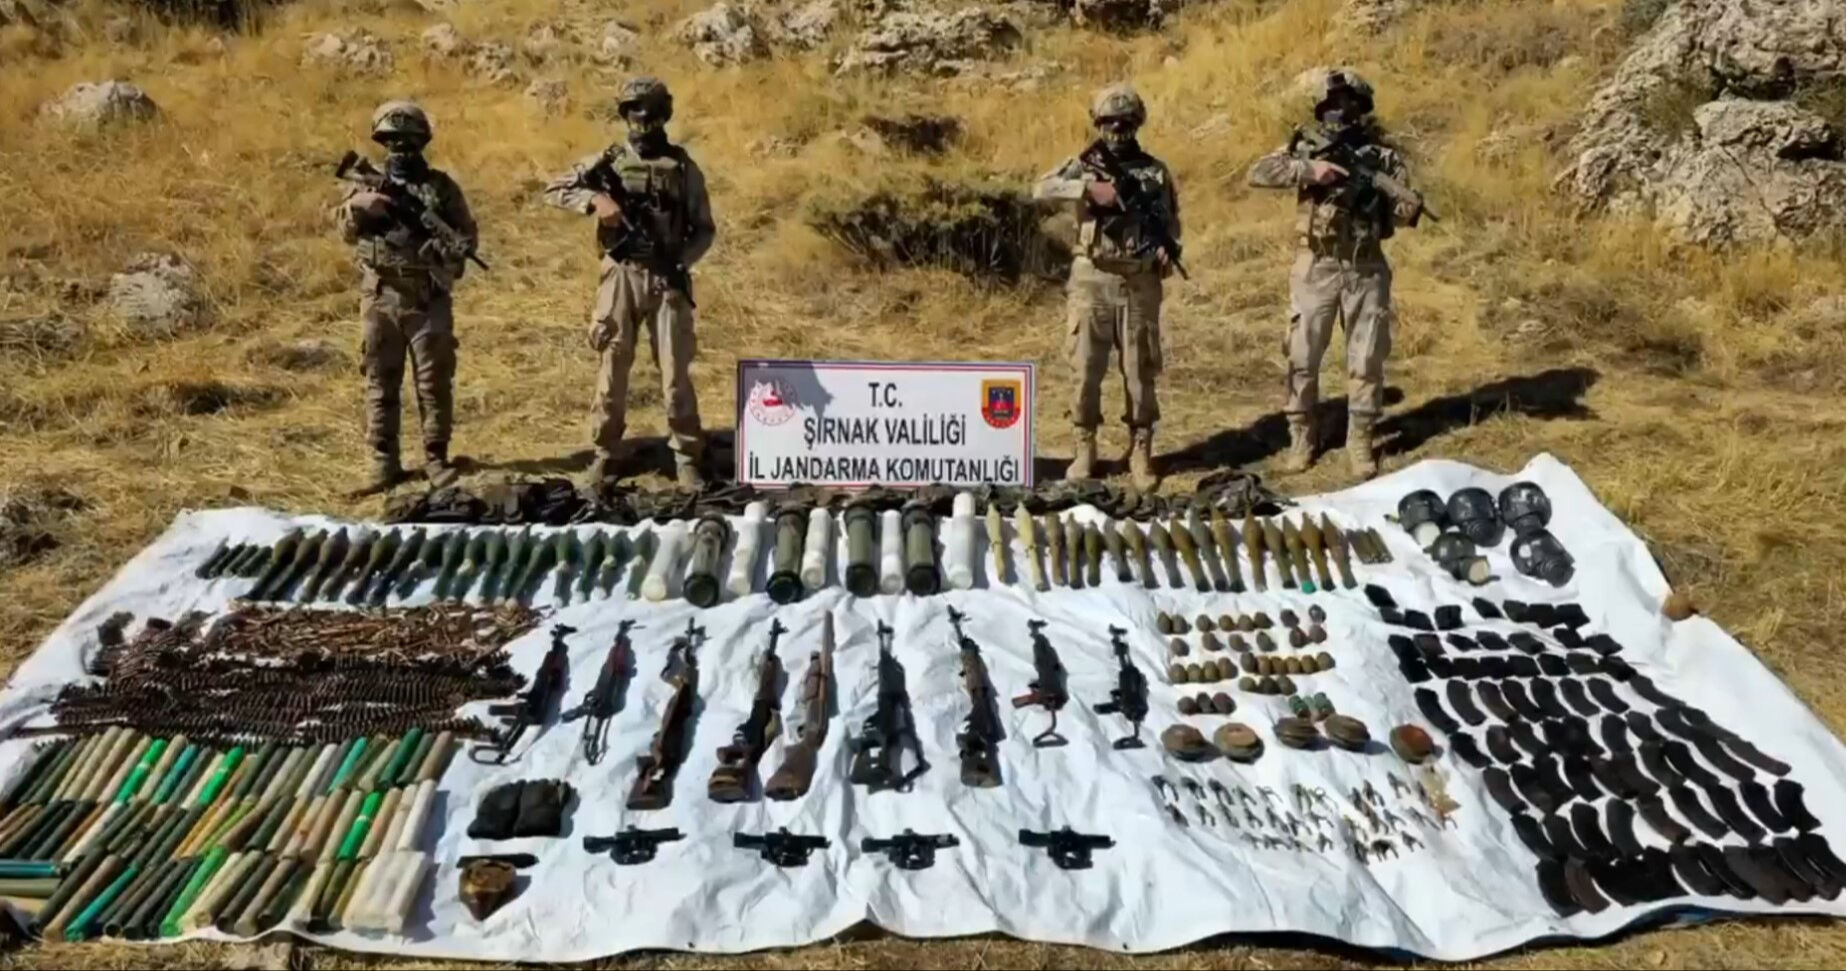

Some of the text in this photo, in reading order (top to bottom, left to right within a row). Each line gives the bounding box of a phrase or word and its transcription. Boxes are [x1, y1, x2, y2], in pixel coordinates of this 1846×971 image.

[868, 382, 903, 408] T.C.
[803, 416, 879, 450] ŞIRNAK
[885, 413, 967, 446] VALİLİĞİ
[749, 451, 1019, 482] İL JANDARMA KOMUTANLIĞI
